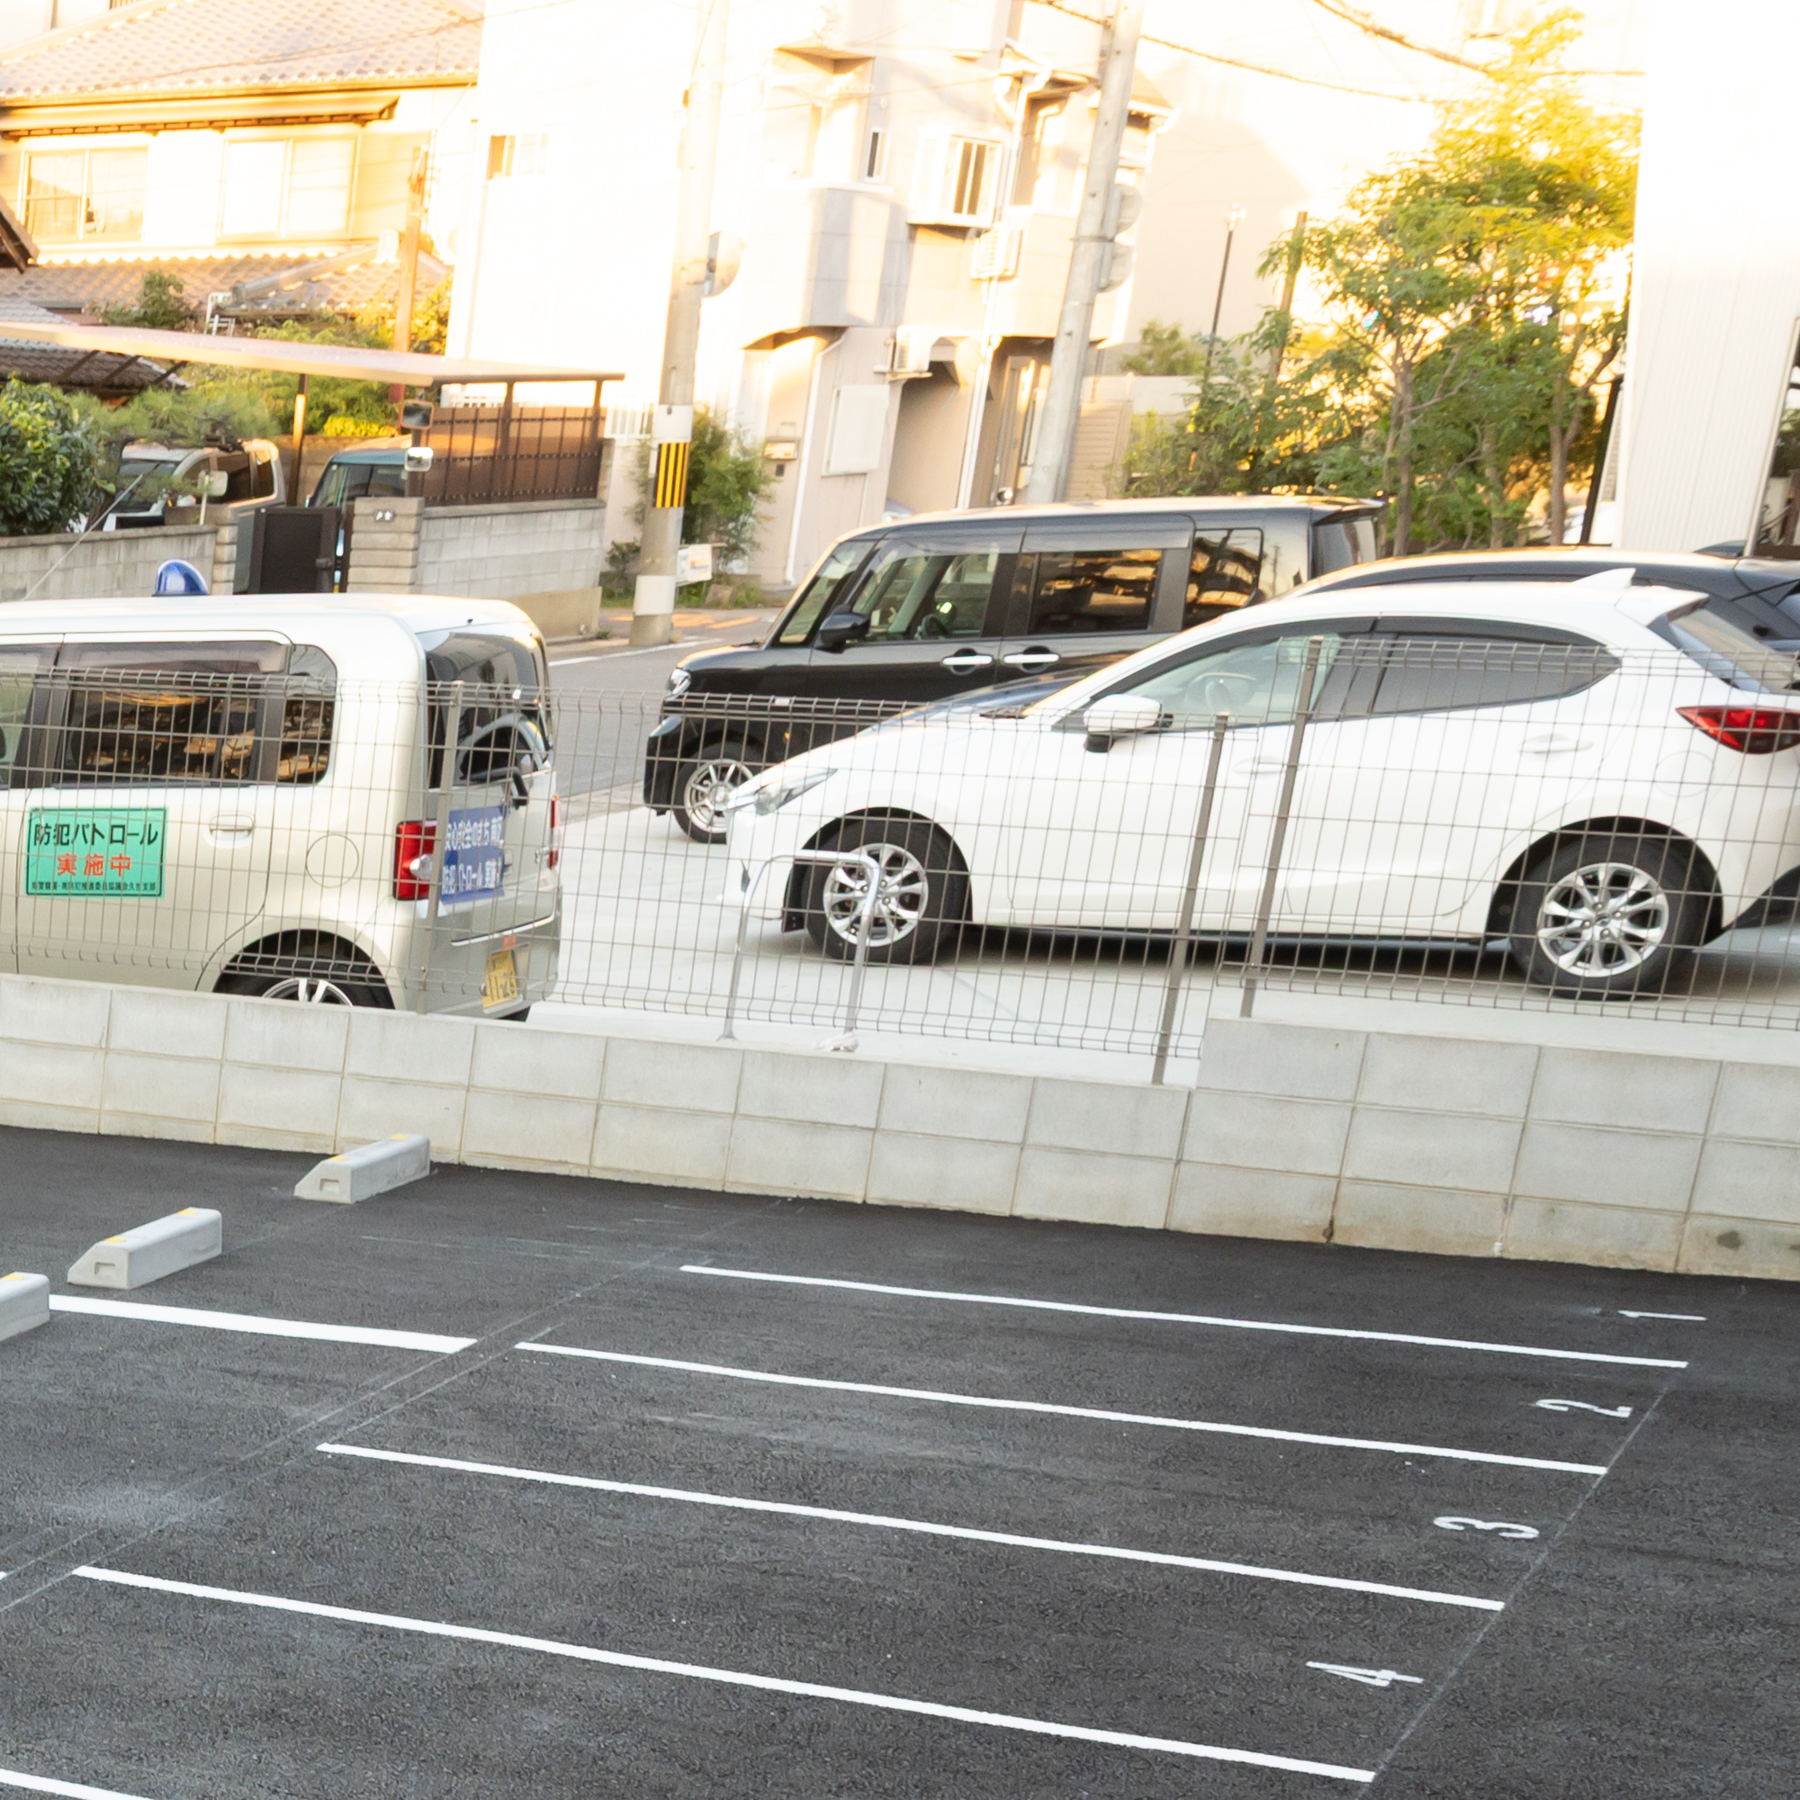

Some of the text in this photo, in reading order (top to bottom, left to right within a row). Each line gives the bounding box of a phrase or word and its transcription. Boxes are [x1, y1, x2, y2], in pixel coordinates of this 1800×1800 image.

[33, 822, 159, 846] 防犯パトロール
[56, 852, 132, 877] 実施中
[1617, 1309, 1707, 1321] 1
[1535, 1398, 1633, 1419] 2
[1432, 1515, 1540, 1539] 3
[1305, 1660, 1424, 1688] 4
